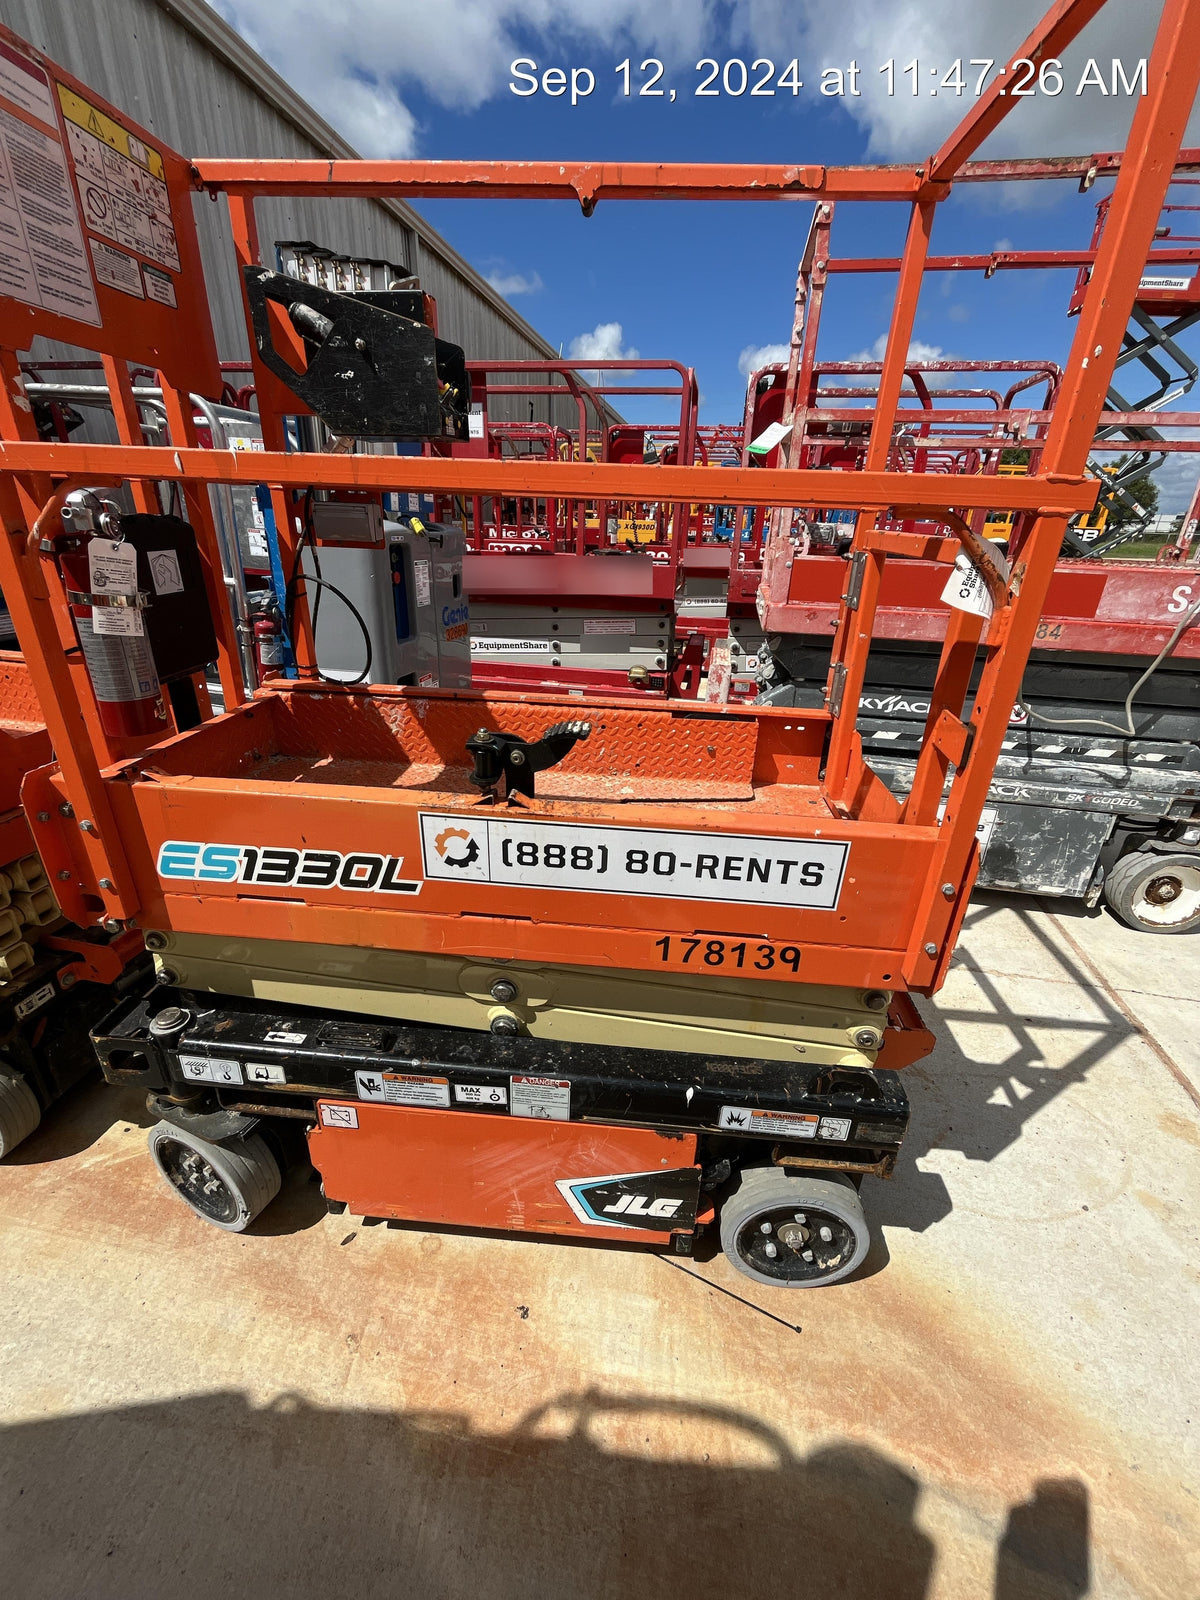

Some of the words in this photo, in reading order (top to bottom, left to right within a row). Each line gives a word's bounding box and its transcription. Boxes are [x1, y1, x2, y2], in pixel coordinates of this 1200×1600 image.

[478, 641, 548, 651] EquipmentShare
[158, 841, 423, 895] ES1330L
[501, 838, 609, 874] (888)
[625, 849, 826, 887] 80-RENTS
[655, 935, 802, 973] 178139
[400, 1075, 434, 1083] WARNING
[528, 1077, 561, 1088] DANGER
[460, 1086, 481, 1094] MAX
[770, 1112, 806, 1121] WARNING
[603, 1194, 684, 1218] JLG
